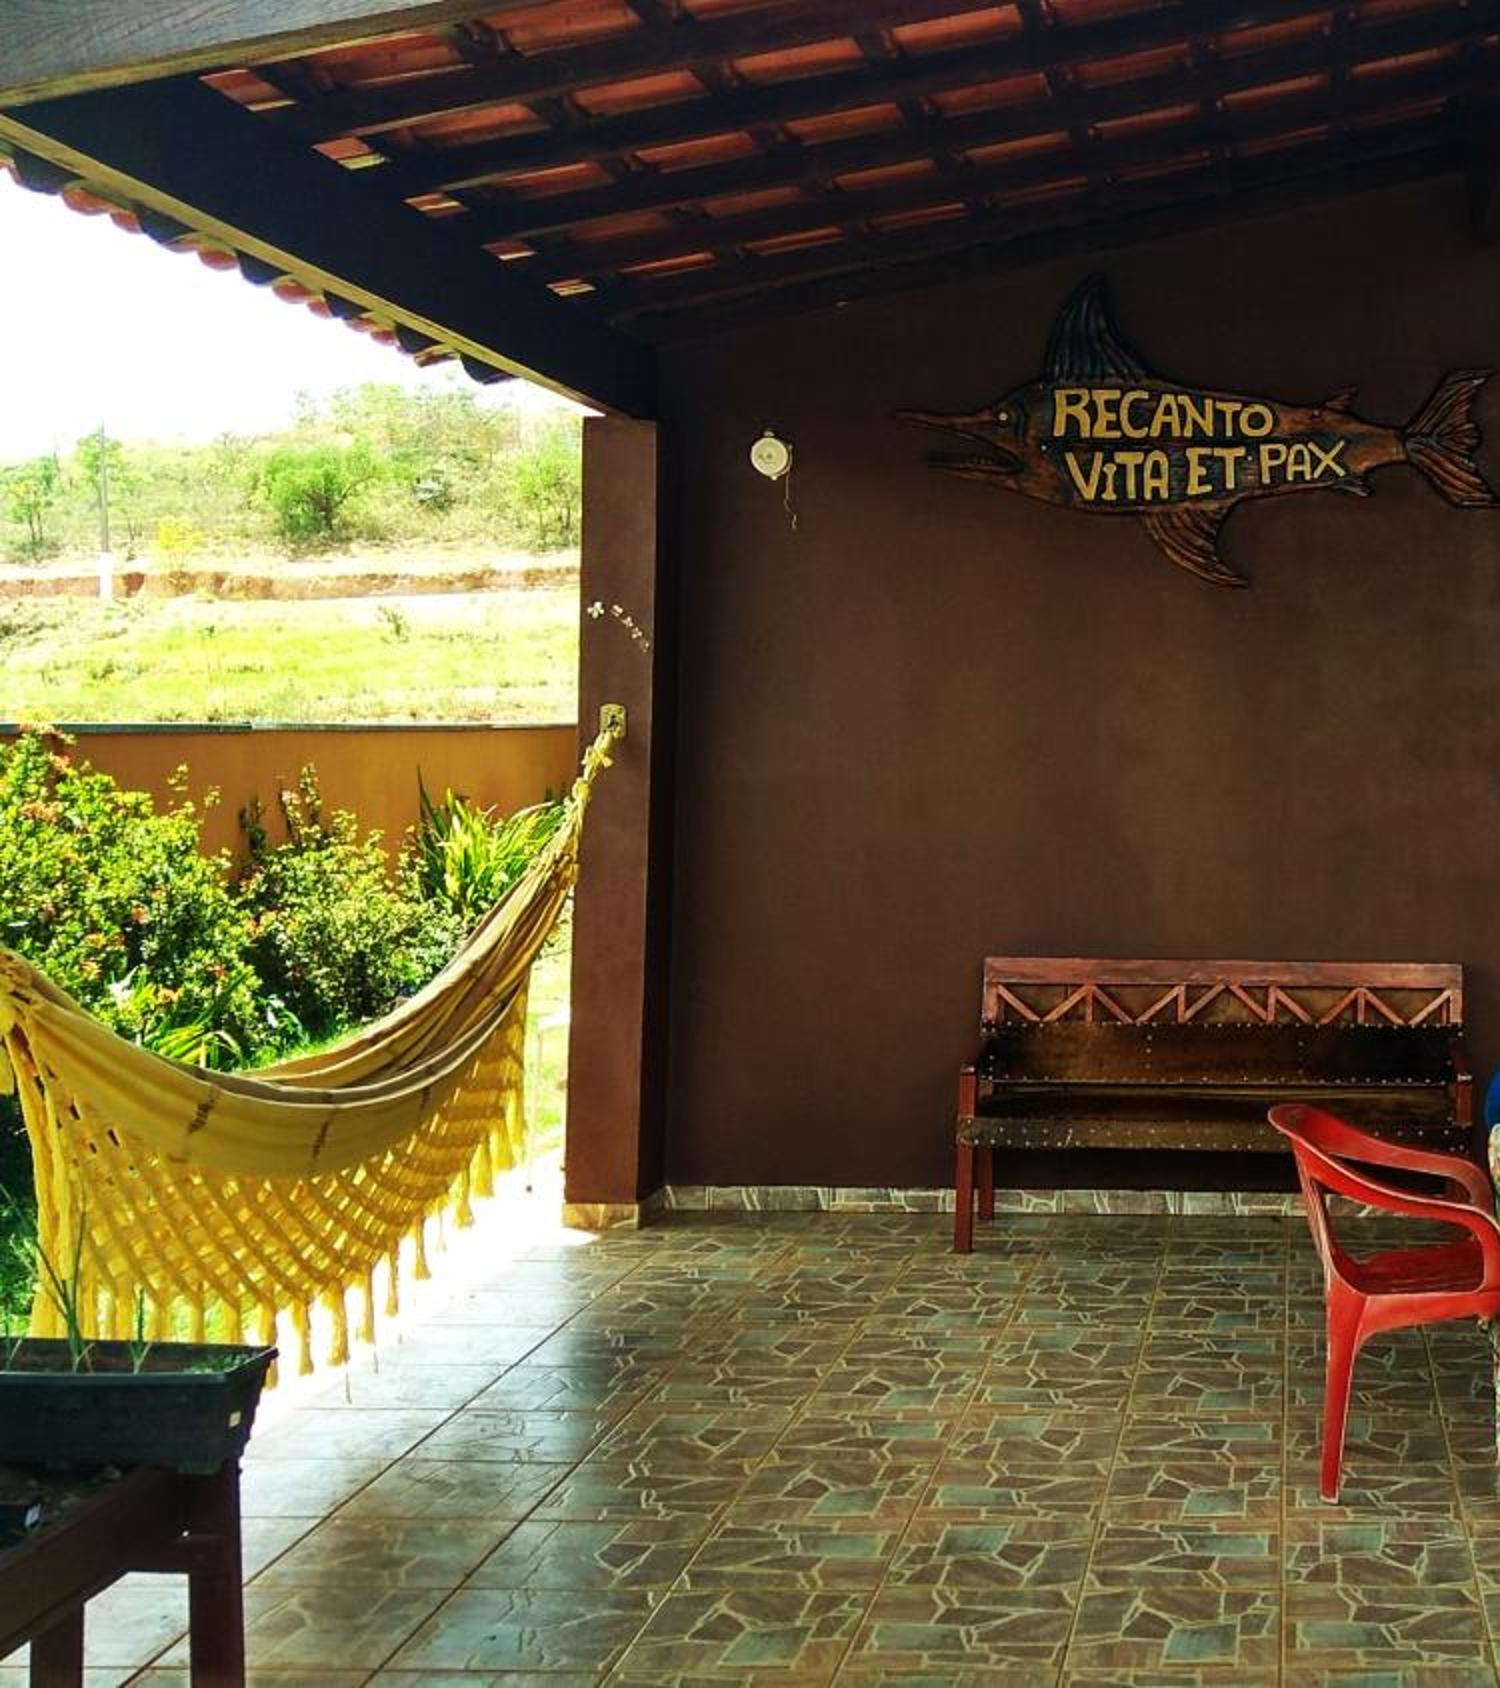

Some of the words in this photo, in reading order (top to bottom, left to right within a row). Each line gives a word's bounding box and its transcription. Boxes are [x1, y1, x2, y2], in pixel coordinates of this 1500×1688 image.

[1053, 389, 1274, 438] RECANTO
[1185, 447, 1244, 495] ET
[1260, 440, 1346, 484] PAX
